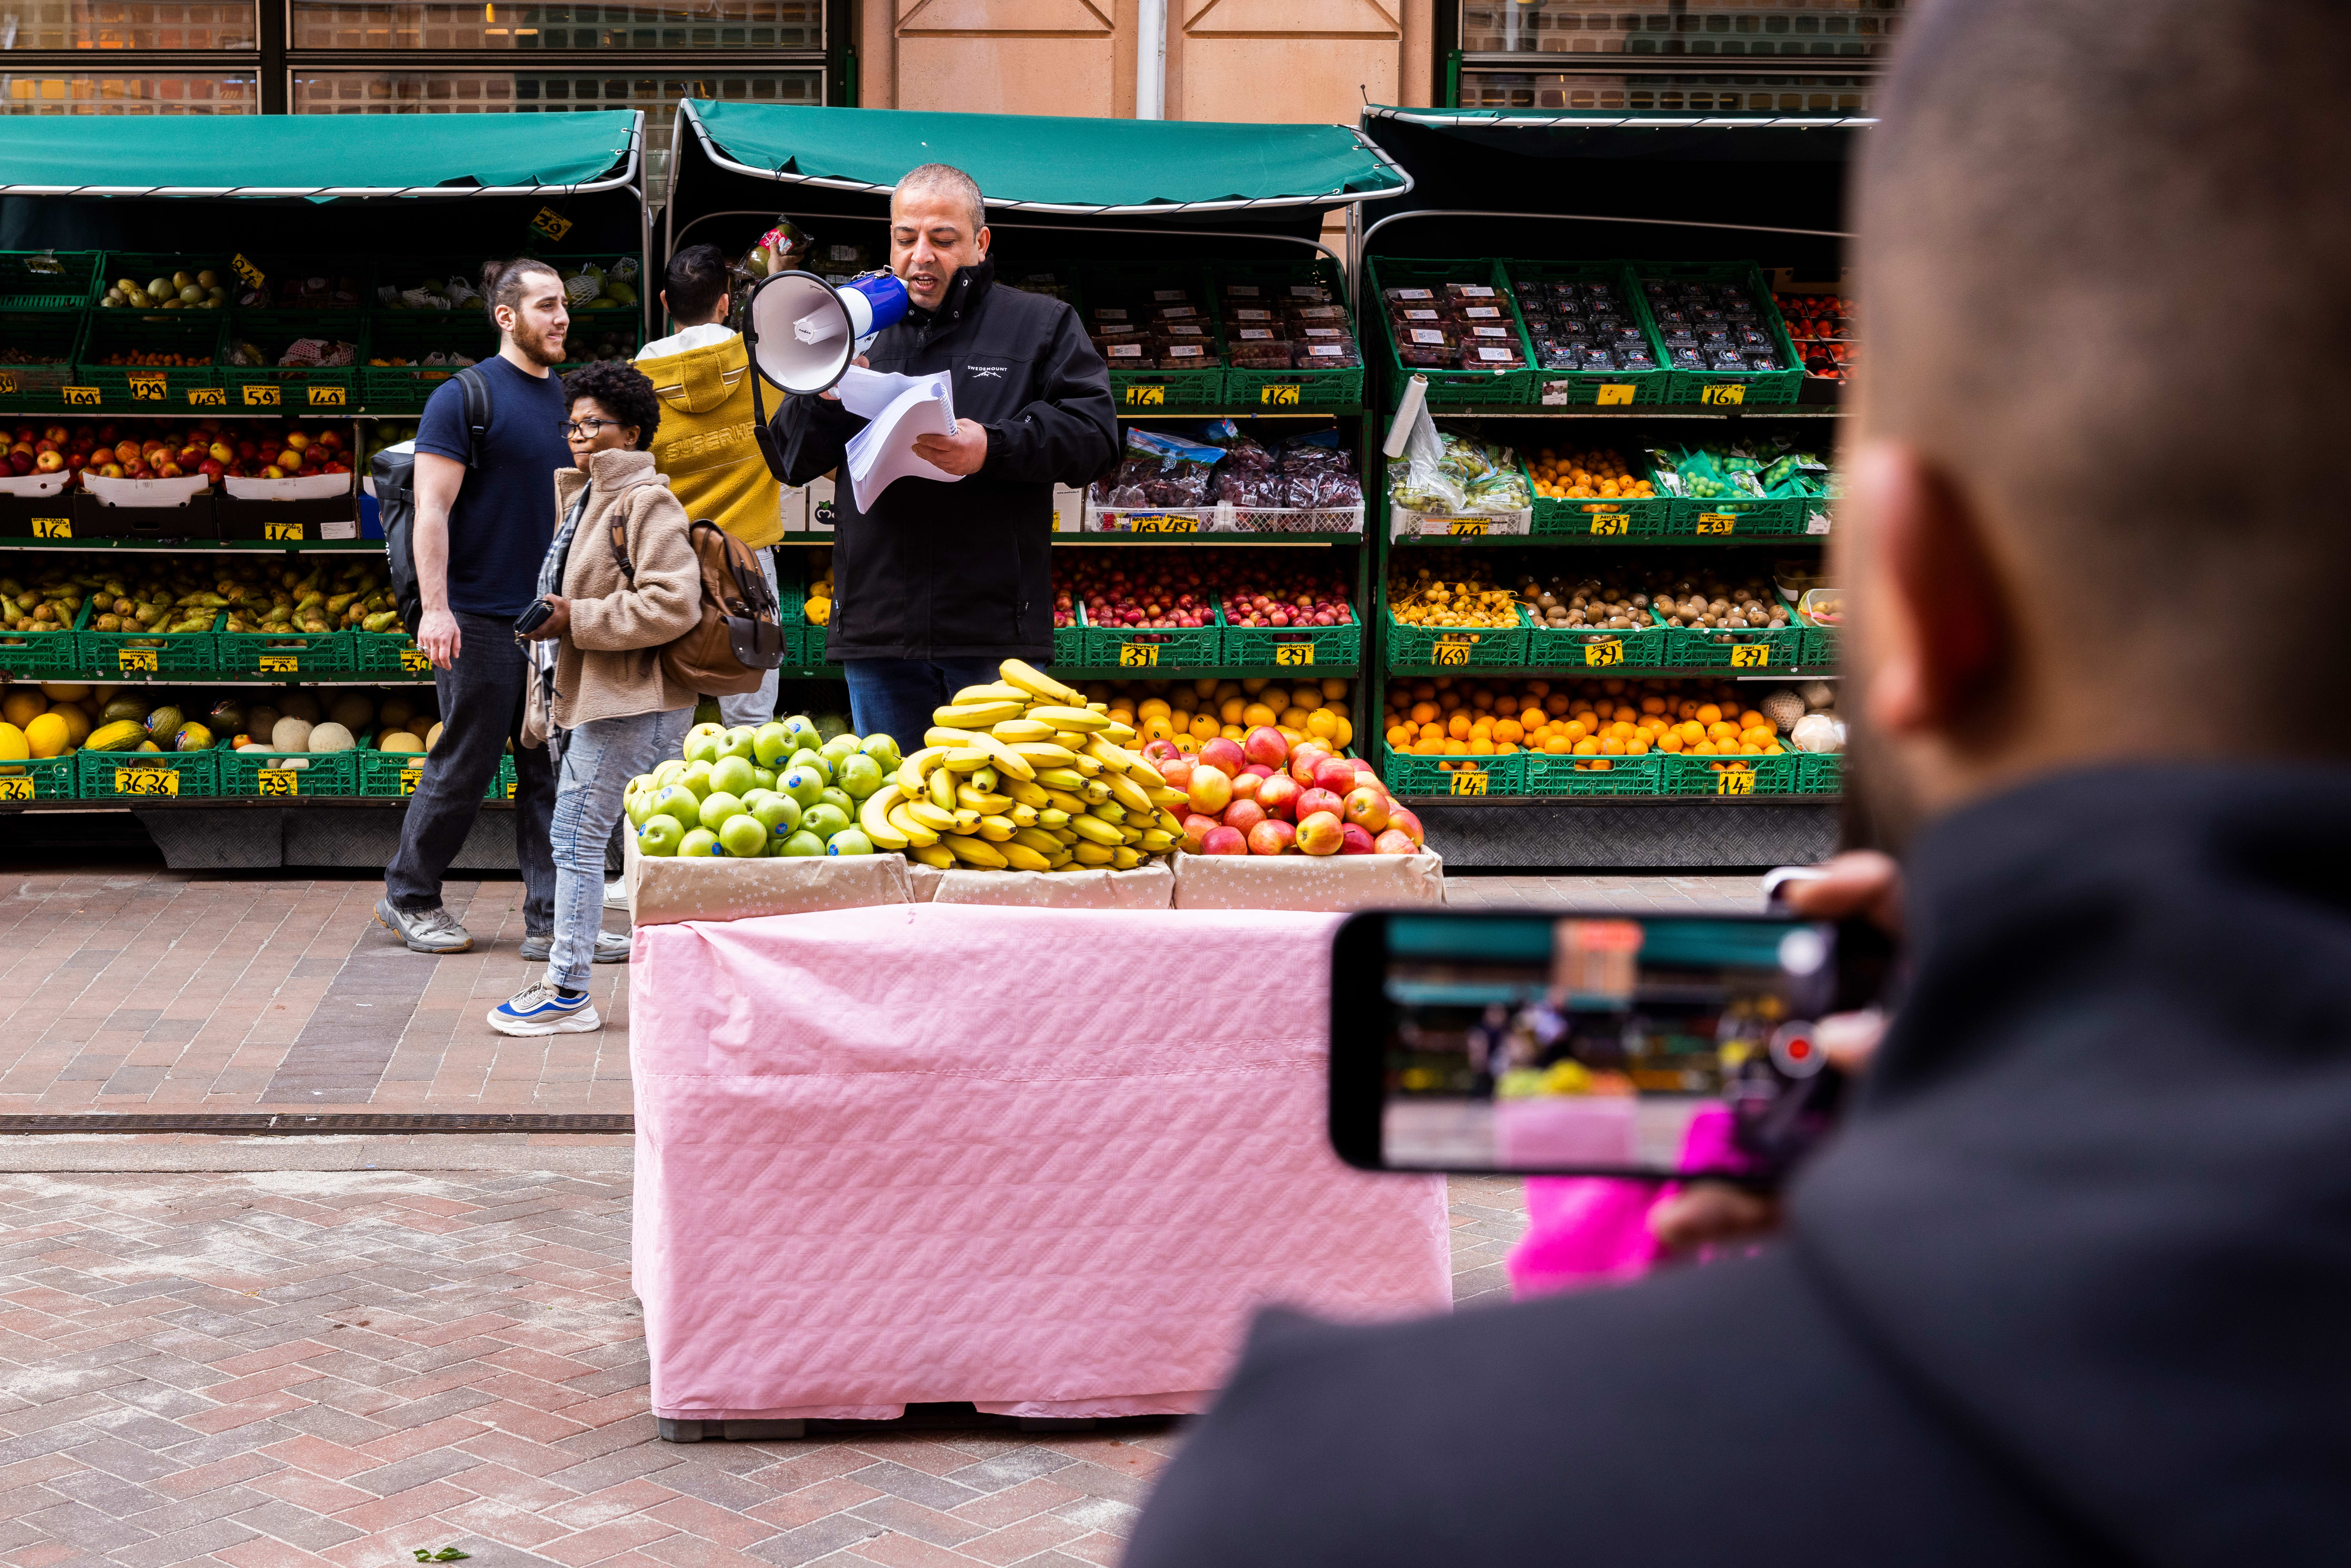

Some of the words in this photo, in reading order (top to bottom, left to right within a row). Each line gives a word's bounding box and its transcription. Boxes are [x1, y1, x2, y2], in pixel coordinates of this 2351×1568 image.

[532, 213, 562, 234] 39
[132, 383, 165, 400] 129
[248, 391, 274, 405] 59
[312, 391, 340, 403] 49
[1131, 390, 1153, 405] 16
[1265, 390, 1289, 405] 16
[1707, 389, 1729, 405] 16
[39, 522, 62, 538] 16
[268, 527, 292, 540] 16
[1164, 519, 1192, 532] 49
[1596, 519, 1622, 534] 39
[1699, 521, 1725, 534] 39
[1125, 648, 1150, 666] 39
[1281, 649, 1306, 665] 39
[1433, 647, 1465, 665] 169
[1591, 646, 1616, 666] 39
[1736, 649, 1761, 667] 39
[0, 782, 26, 800] 36
[119, 773, 142, 793] 36
[145, 774, 170, 794] 36
[259, 777, 288, 795] 39
[1453, 777, 1480, 795] 14
[1720, 777, 1748, 794] 14
